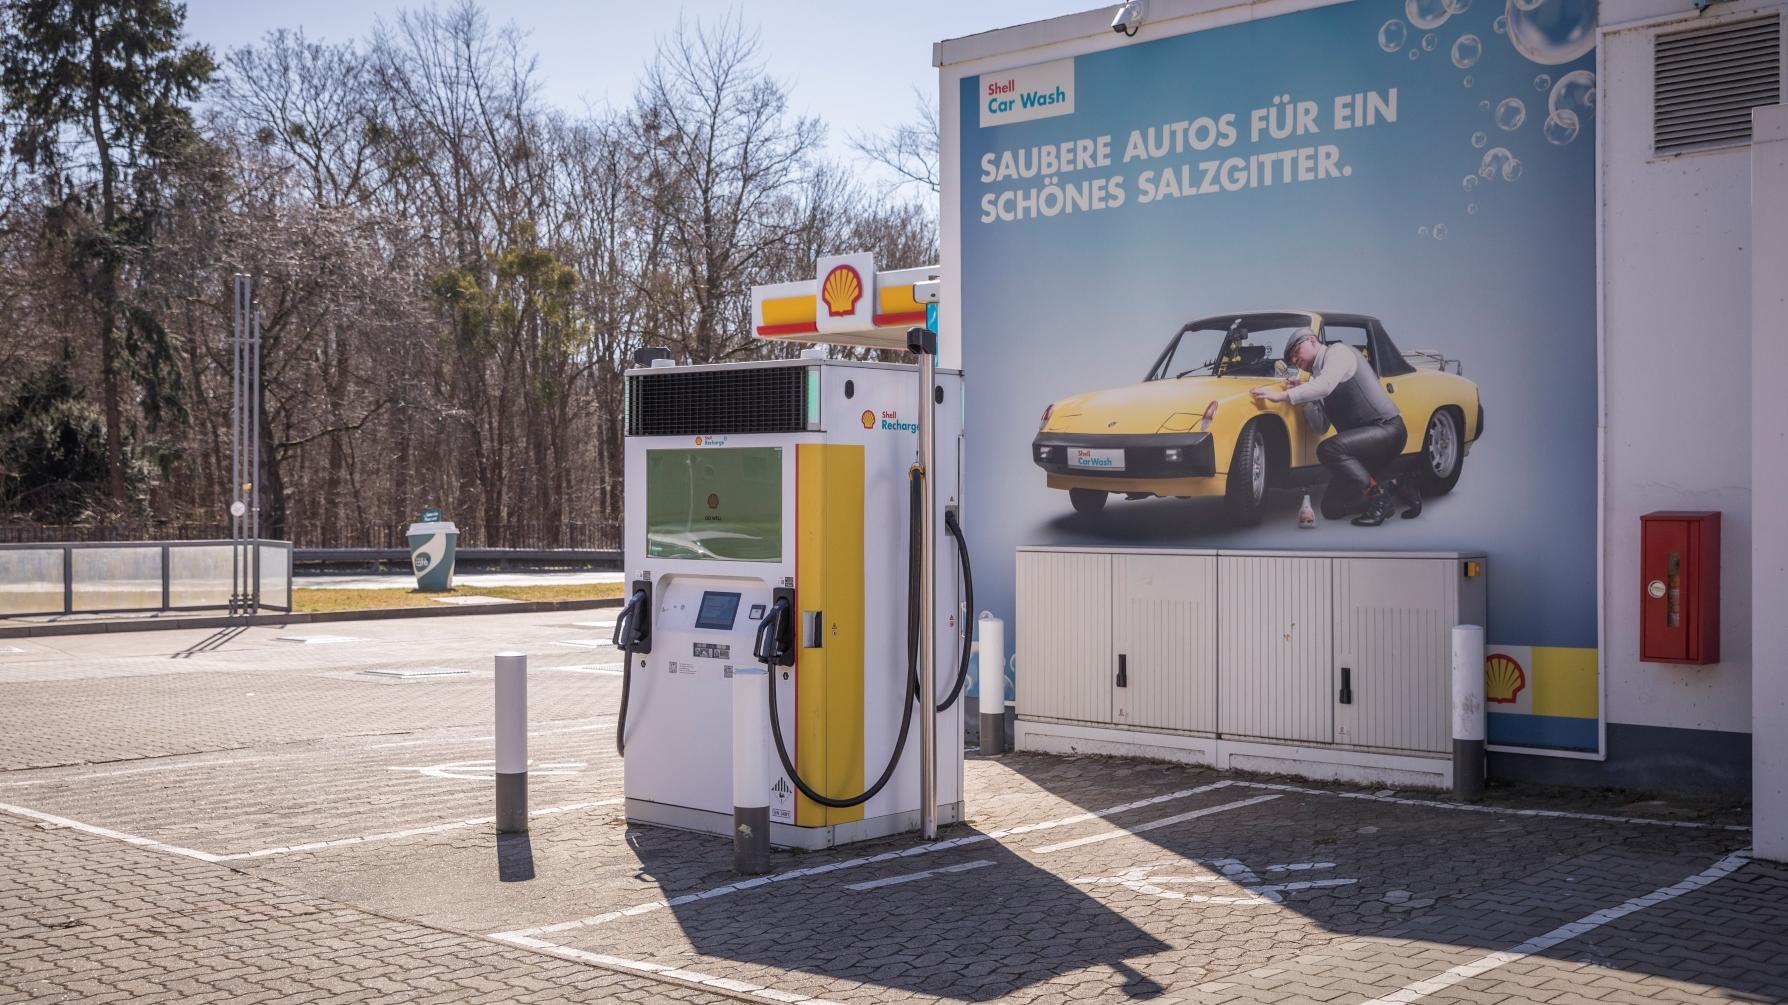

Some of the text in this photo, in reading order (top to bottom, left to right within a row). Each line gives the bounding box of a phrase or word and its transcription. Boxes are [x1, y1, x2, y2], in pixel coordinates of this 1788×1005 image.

[988, 79, 1015, 95] Shell
[988, 85, 1066, 114] Car Wash
[980, 87, 1399, 184] SAUBERE AUTOS FÜR EIN
[980, 144, 1353, 225] SCHÖNES SALZGITTER.
[881, 411, 897, 419] Shell
